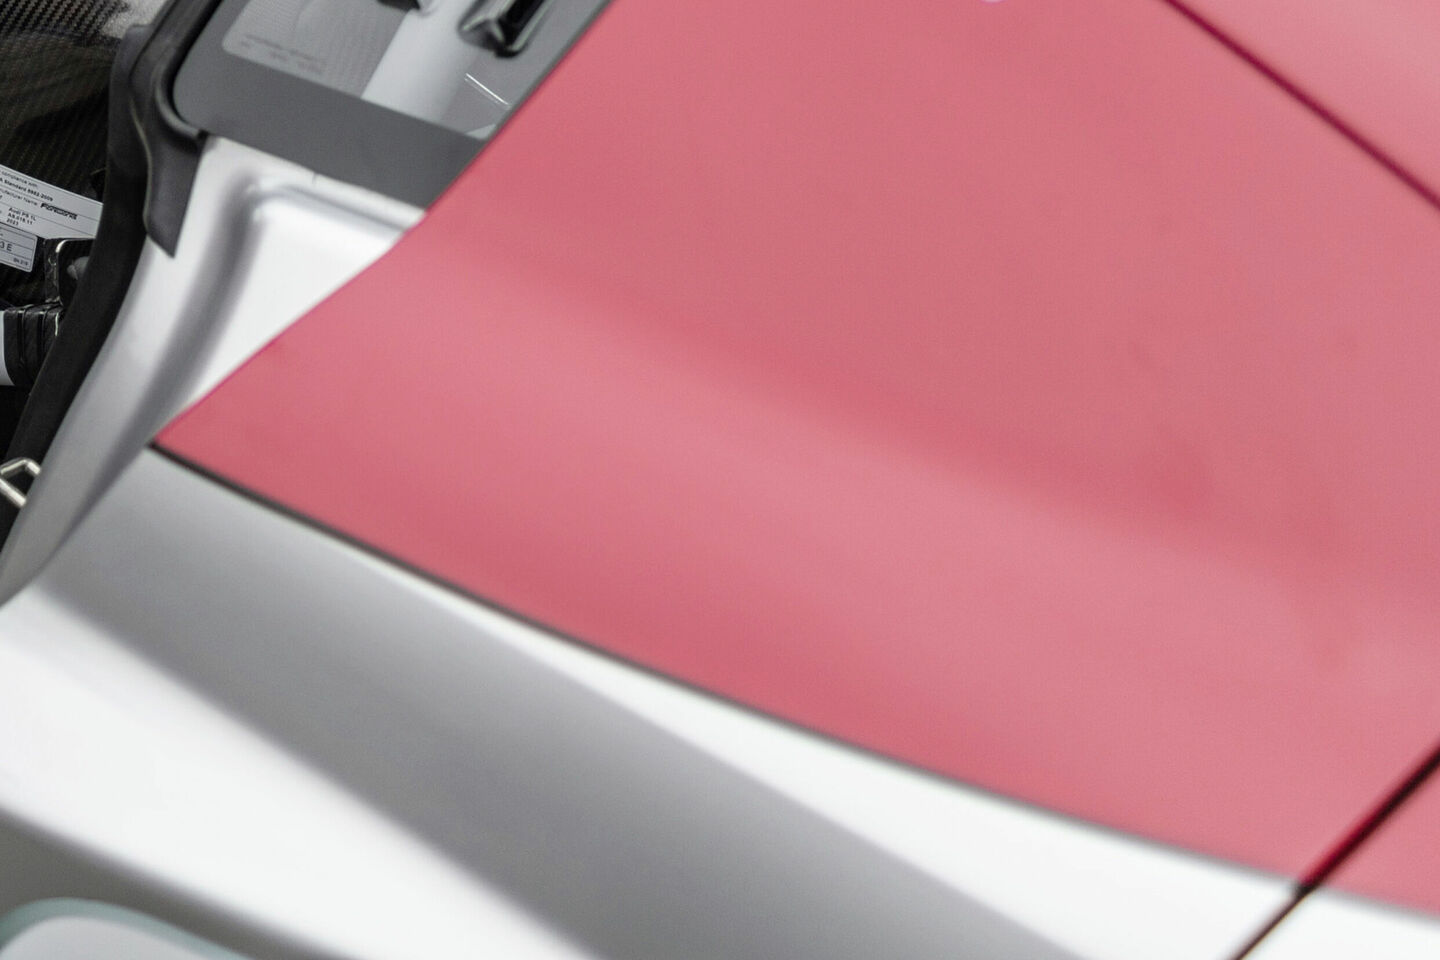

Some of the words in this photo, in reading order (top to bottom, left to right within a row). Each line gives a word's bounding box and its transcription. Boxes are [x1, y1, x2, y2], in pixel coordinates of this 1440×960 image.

[4, 178, 27, 191] Standard
[8, 207, 21, 215] Audi
[6, 243, 13, 252] E
